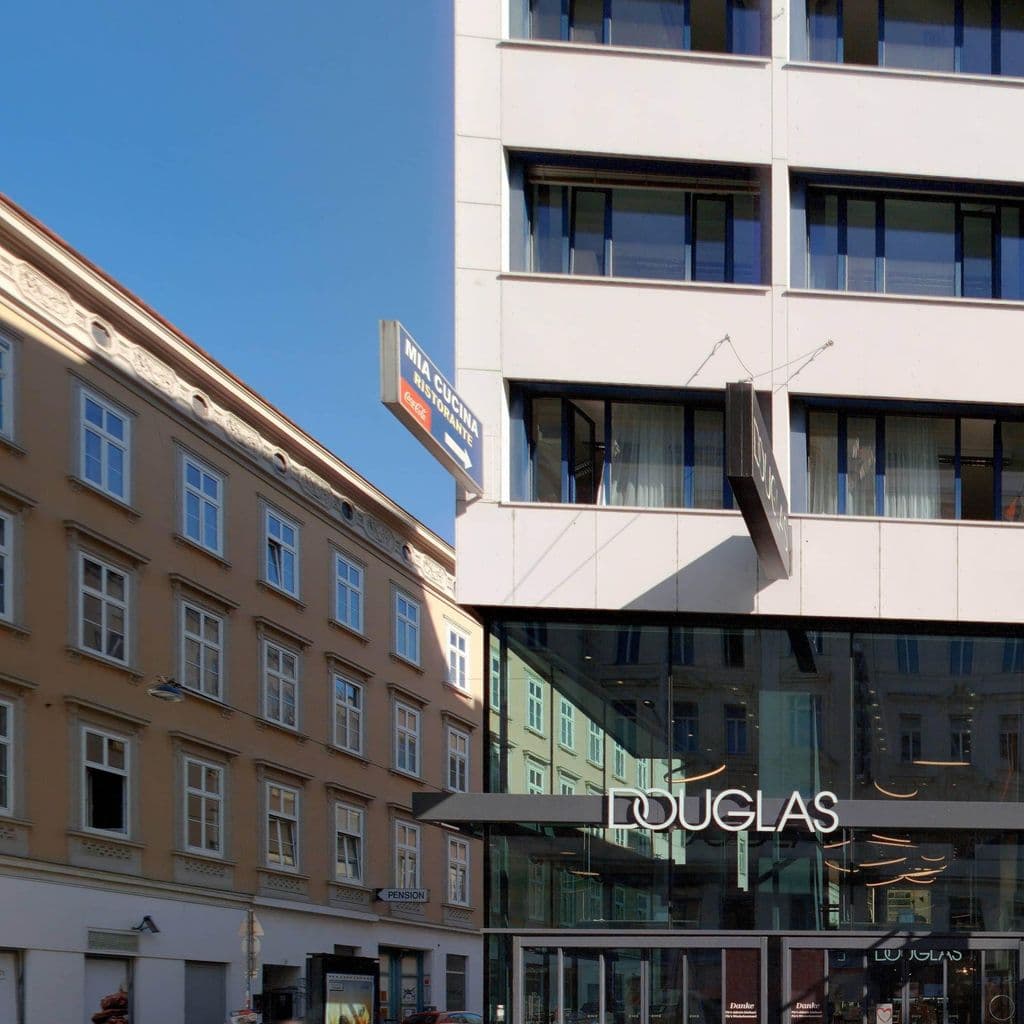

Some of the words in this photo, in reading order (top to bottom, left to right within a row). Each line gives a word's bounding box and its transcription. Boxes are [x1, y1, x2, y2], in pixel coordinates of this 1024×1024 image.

[405, 338, 431, 381] MIA
[434, 374, 480, 438] CUCINA
[413, 371, 473, 448] RISTORANTE
[608, 787, 840, 833] DOUGLAS
[388, 891, 425, 900] PENSION
[730, 1002, 755, 1010] Danke
[796, 1002, 820, 1010] Danke
